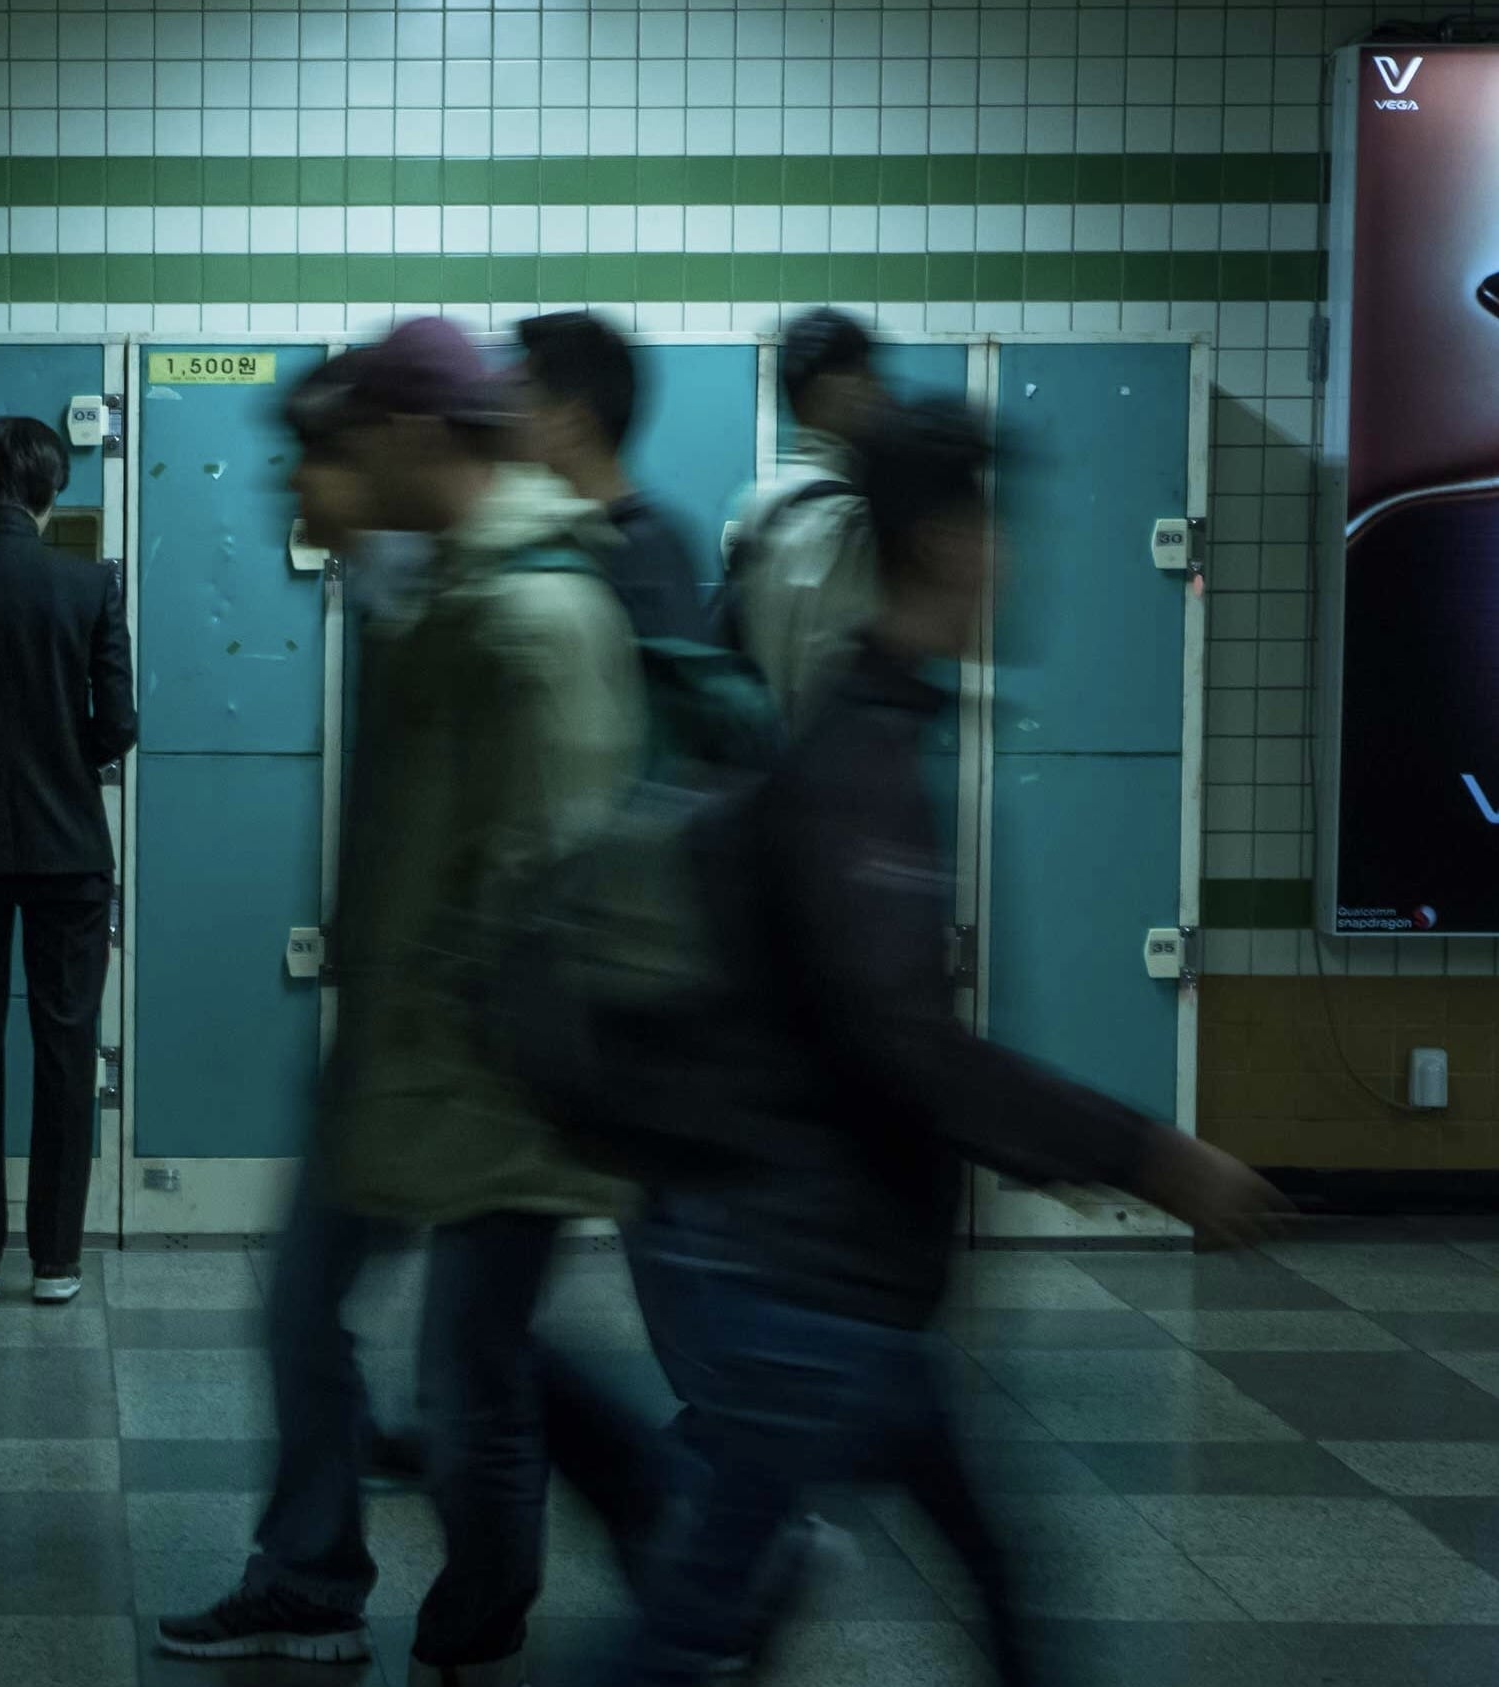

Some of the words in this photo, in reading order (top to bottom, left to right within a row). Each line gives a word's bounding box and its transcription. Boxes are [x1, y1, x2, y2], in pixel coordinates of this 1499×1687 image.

[1373, 99, 1419, 111] VEGA
[167, 357, 256, 376] 1,500원
[74, 410, 96, 421] 05
[1160, 533, 1183, 543] 30
[1338, 906, 1397, 917] Qualcomm
[1338, 917, 1413, 931] snapdragon
[1153, 943, 1175, 953] 35
